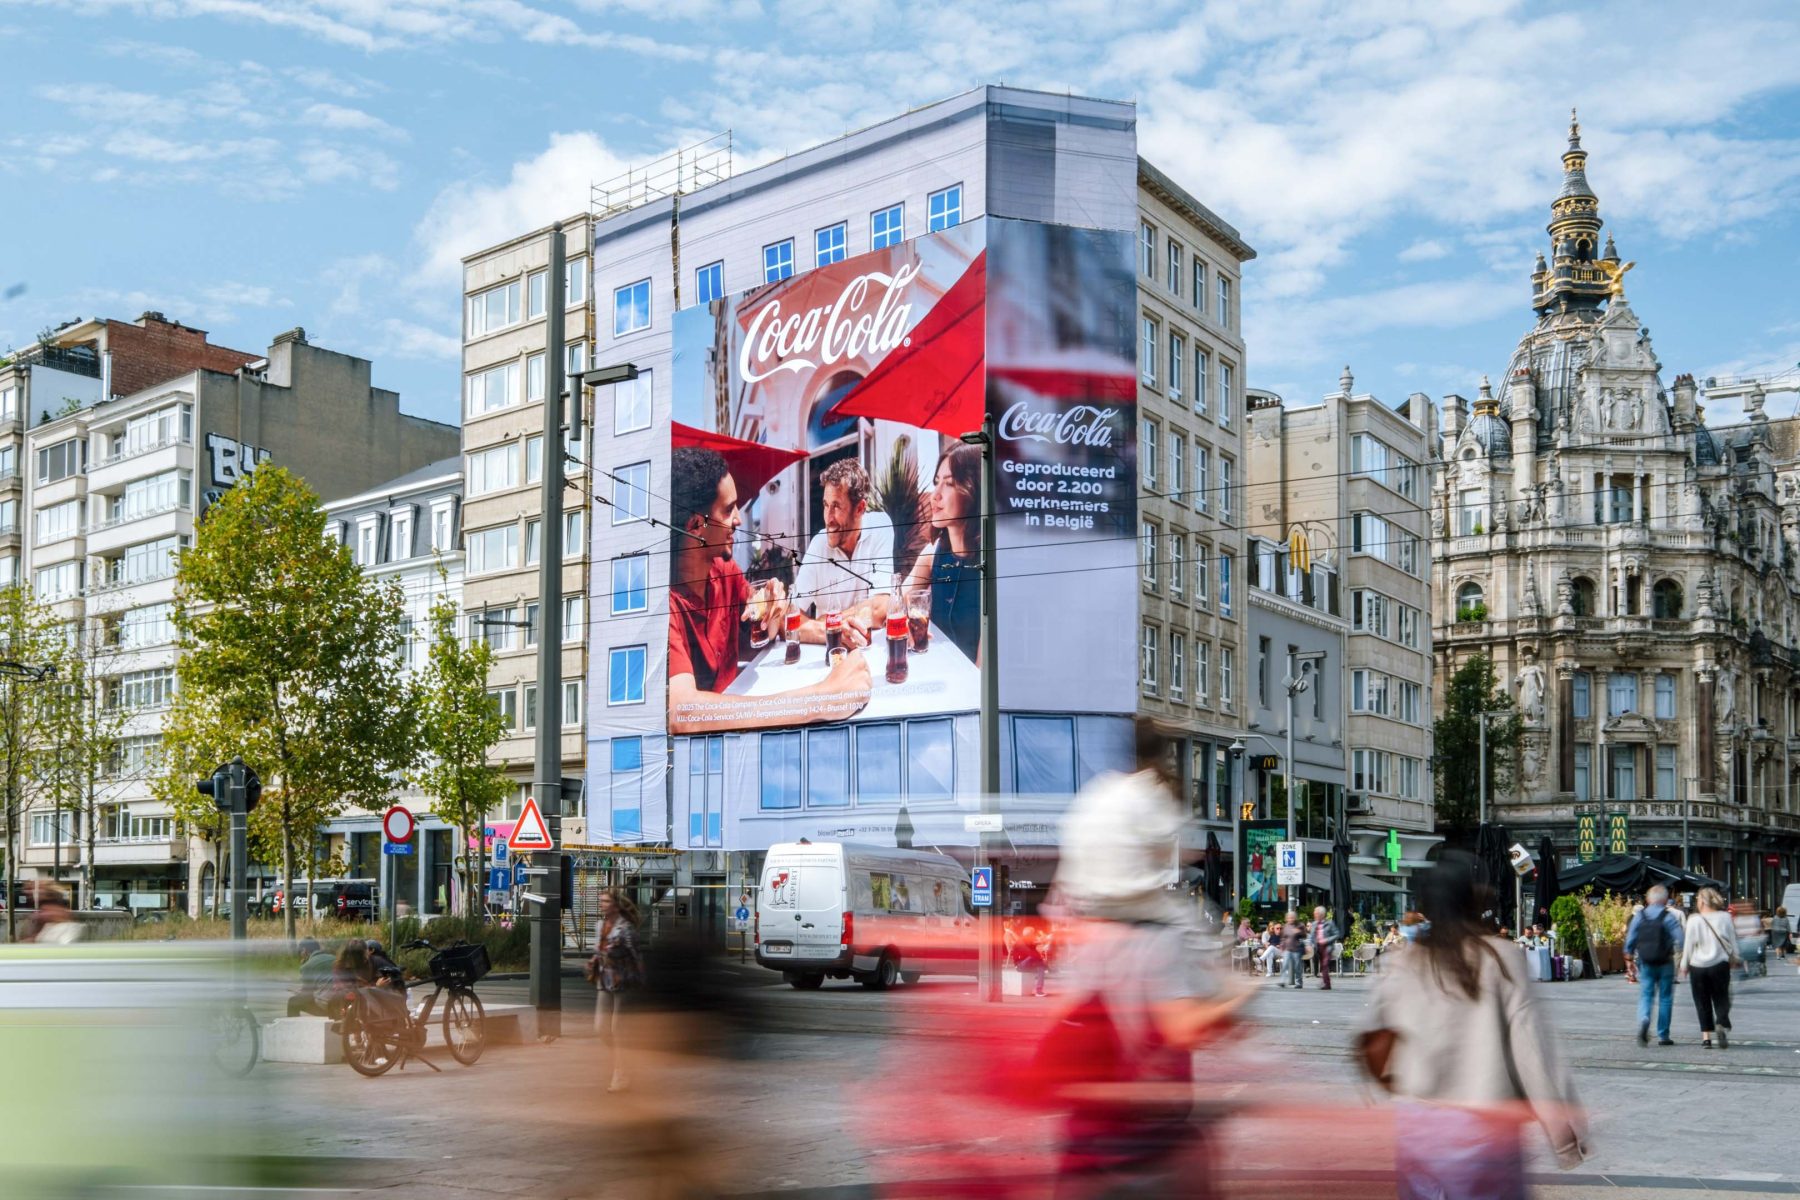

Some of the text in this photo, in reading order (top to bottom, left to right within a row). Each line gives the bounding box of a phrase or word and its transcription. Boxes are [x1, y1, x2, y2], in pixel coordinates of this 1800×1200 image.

[740, 260, 922, 383] Coca-Cola
[999, 401, 1119, 448] Coca-Cola
[1003, 460, 1115, 478] Geproduceerd
[1016, 478, 1102, 494] door 2.200
[1010, 496, 1109, 512] werknemers
[1025, 513, 1094, 530] in België
